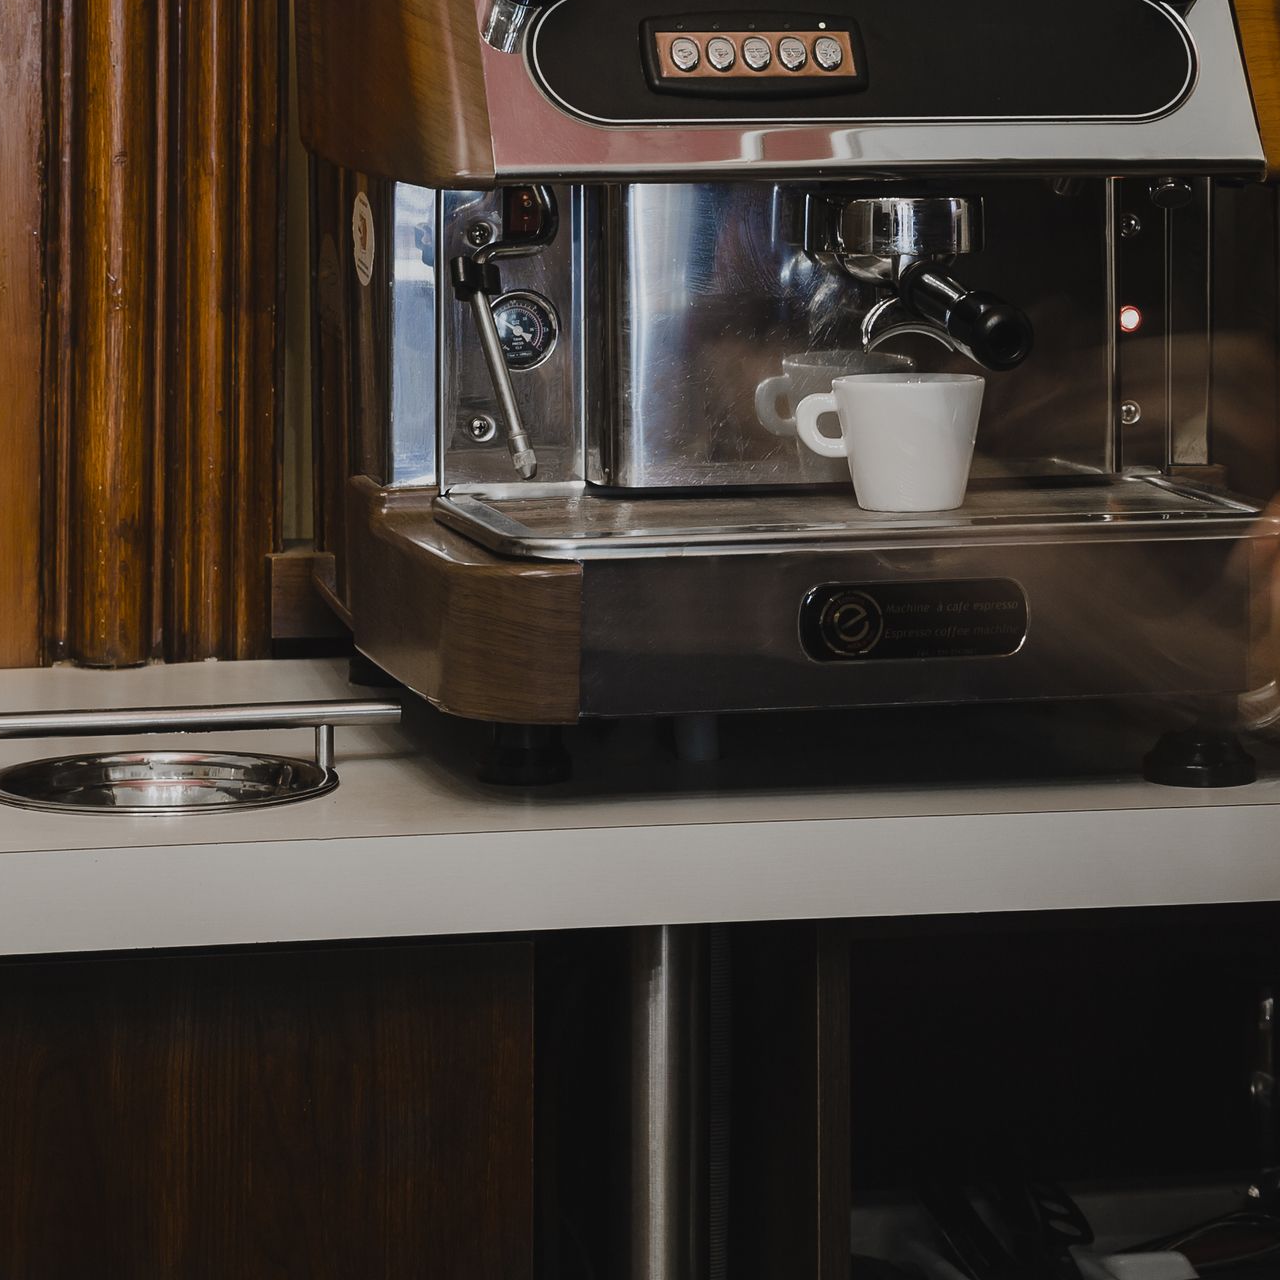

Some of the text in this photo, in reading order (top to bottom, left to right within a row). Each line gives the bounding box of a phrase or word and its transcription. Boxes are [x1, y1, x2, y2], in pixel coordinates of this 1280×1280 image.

[885, 602, 931, 615] Machine
[946, 600, 970, 615] café
[972, 599, 1019, 614] espresso
[883, 625, 933, 640] Espresso
[934, 624, 969, 639] coffee
